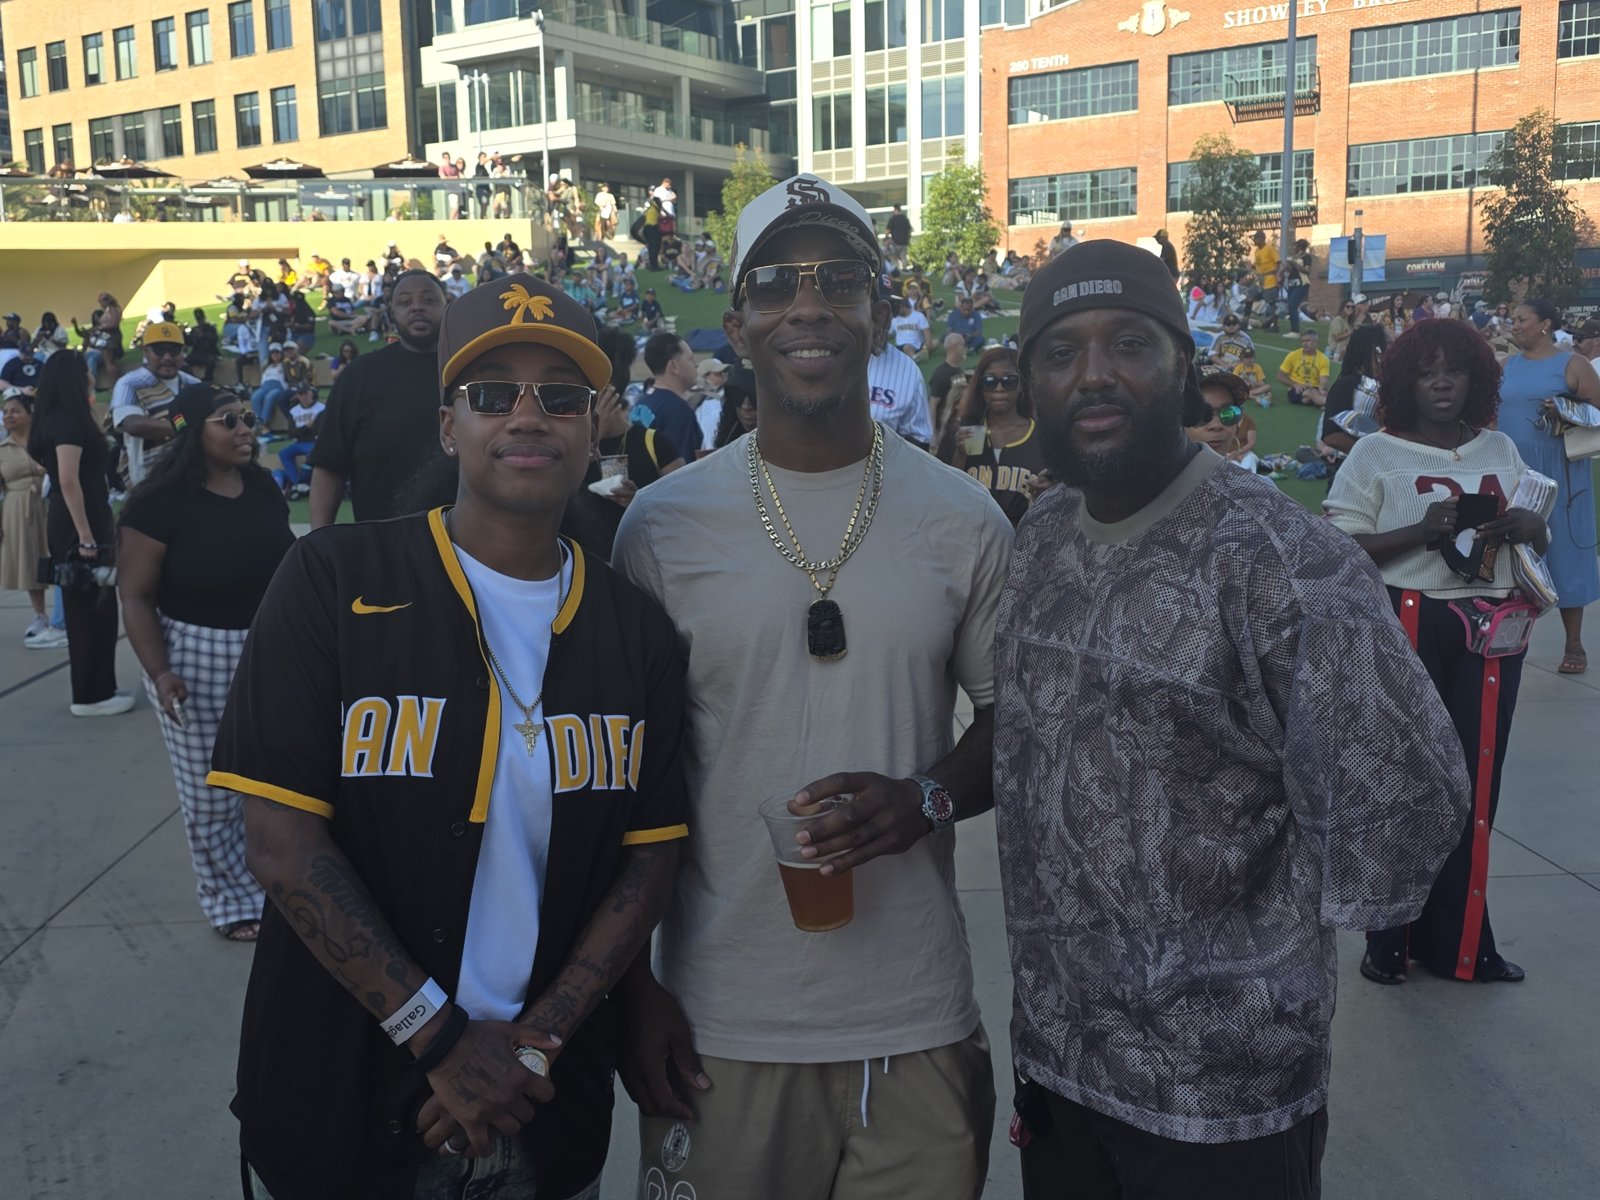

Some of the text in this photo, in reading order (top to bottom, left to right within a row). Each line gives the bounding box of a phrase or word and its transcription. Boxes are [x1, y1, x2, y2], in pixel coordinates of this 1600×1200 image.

[1031, 53, 1070, 70] TENTH
[1053, 279, 1123, 307] SAN DIEGO
